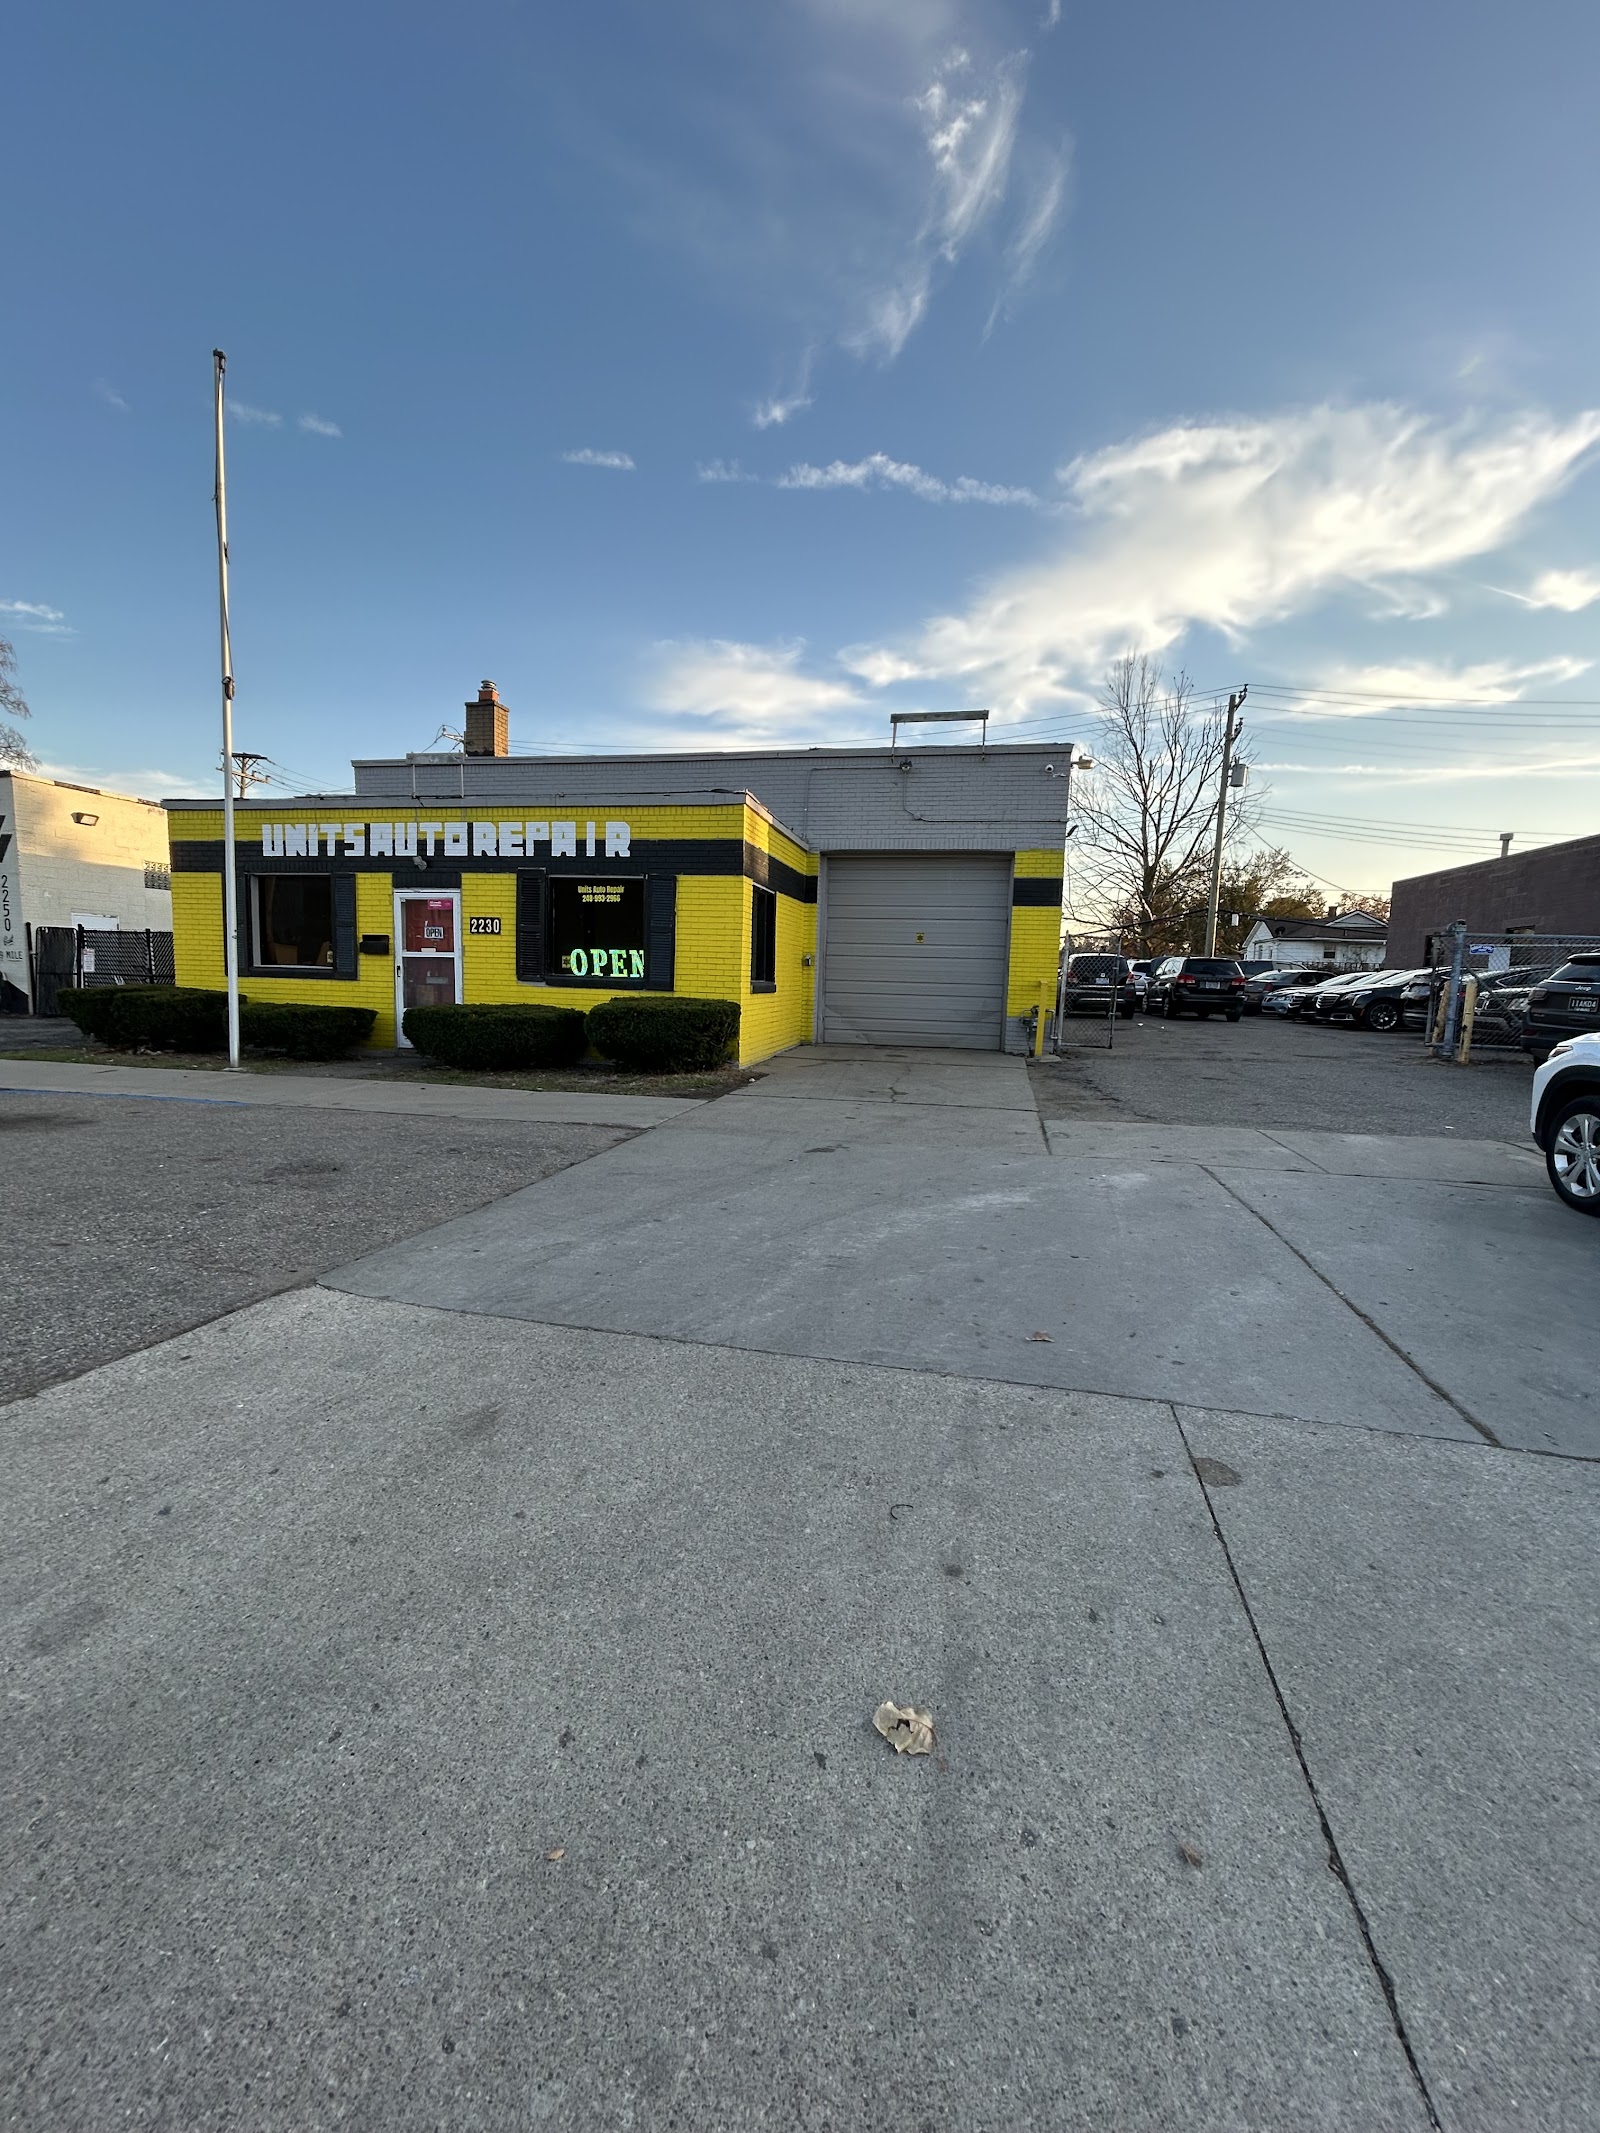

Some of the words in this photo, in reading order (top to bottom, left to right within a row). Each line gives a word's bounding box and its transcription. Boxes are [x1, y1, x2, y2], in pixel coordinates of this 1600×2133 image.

[262, 822, 366, 857] UNITS
[369, 822, 468, 857] AUTO
[473, 821, 631, 858] REPAIR
[577, 885, 592, 893] Units
[592, 885, 606, 893] Auto
[606, 885, 625, 894] Repair
[1, 875, 11, 931] 2250
[425, 927, 442, 937] OPEN
[470, 918, 500, 933] 2230
[5, 950, 23, 960] MILE
[570, 948, 644, 977] OPEN
